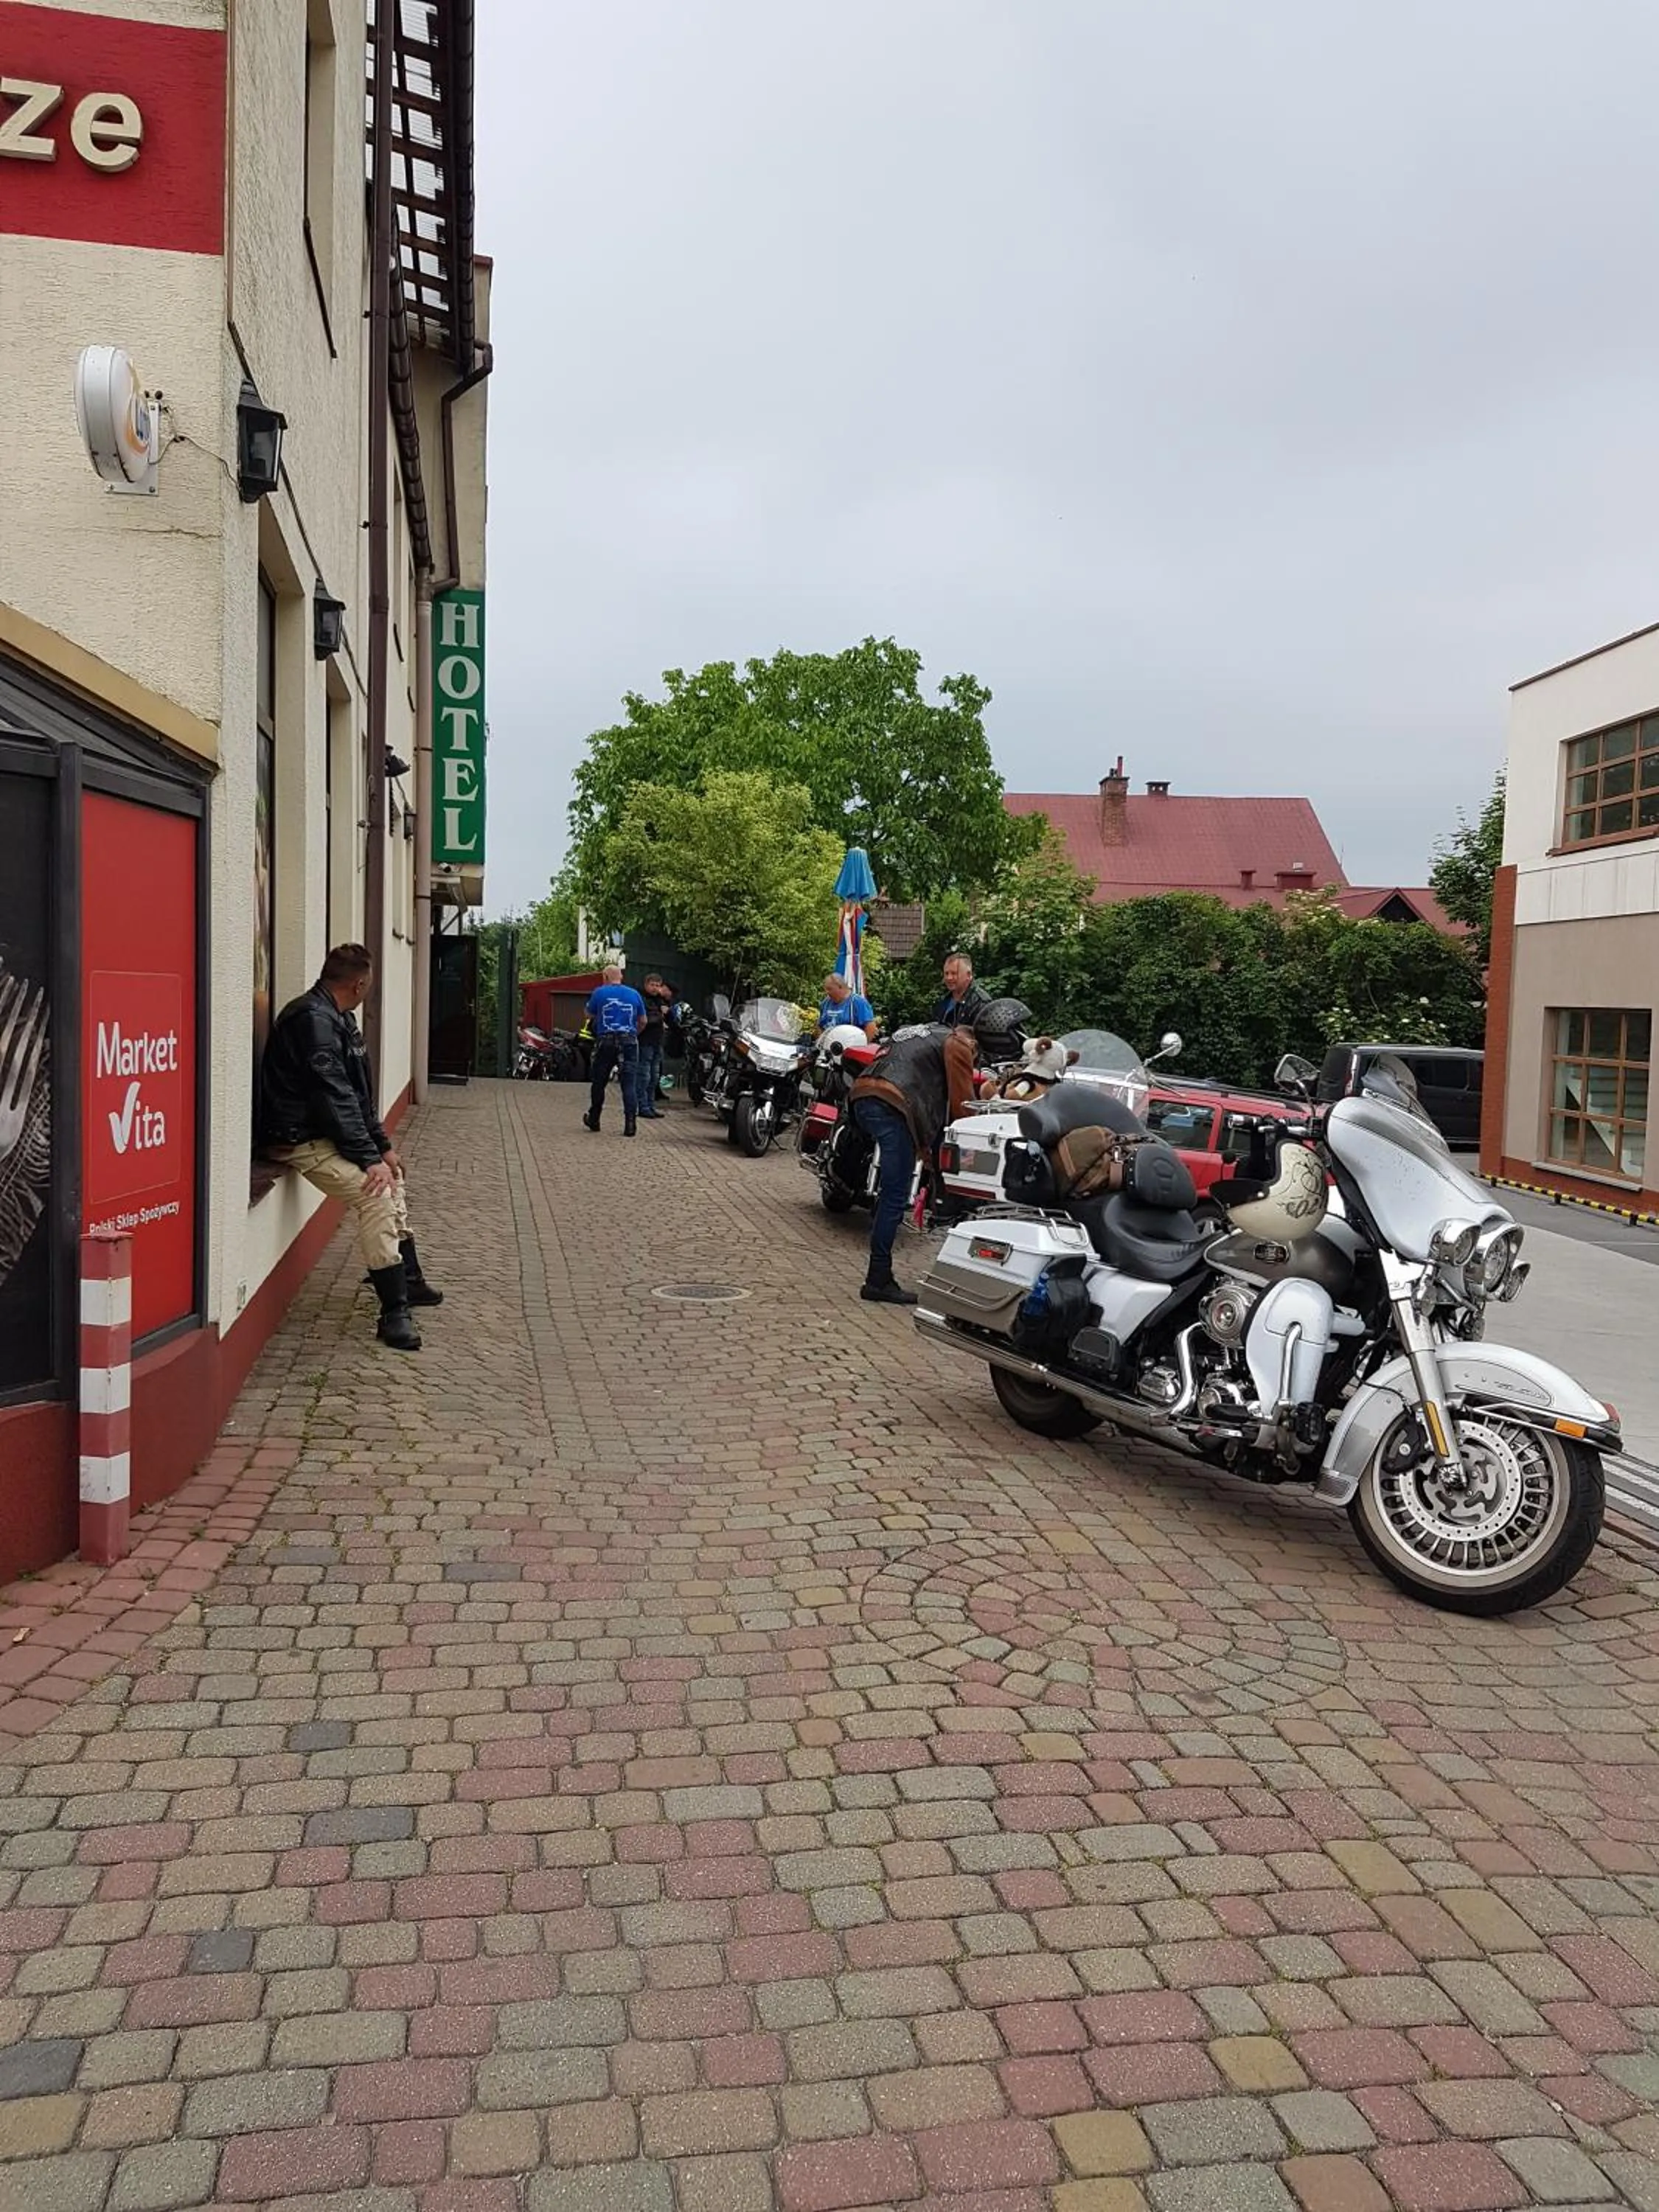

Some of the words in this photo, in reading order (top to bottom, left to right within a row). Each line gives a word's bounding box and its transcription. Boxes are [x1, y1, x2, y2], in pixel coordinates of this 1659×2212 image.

[437, 601, 481, 851] HOTEL
[97, 1021, 178, 1078] Market
[108, 1081, 166, 1154] Vita
[116, 1212, 139, 1230] Sklep
